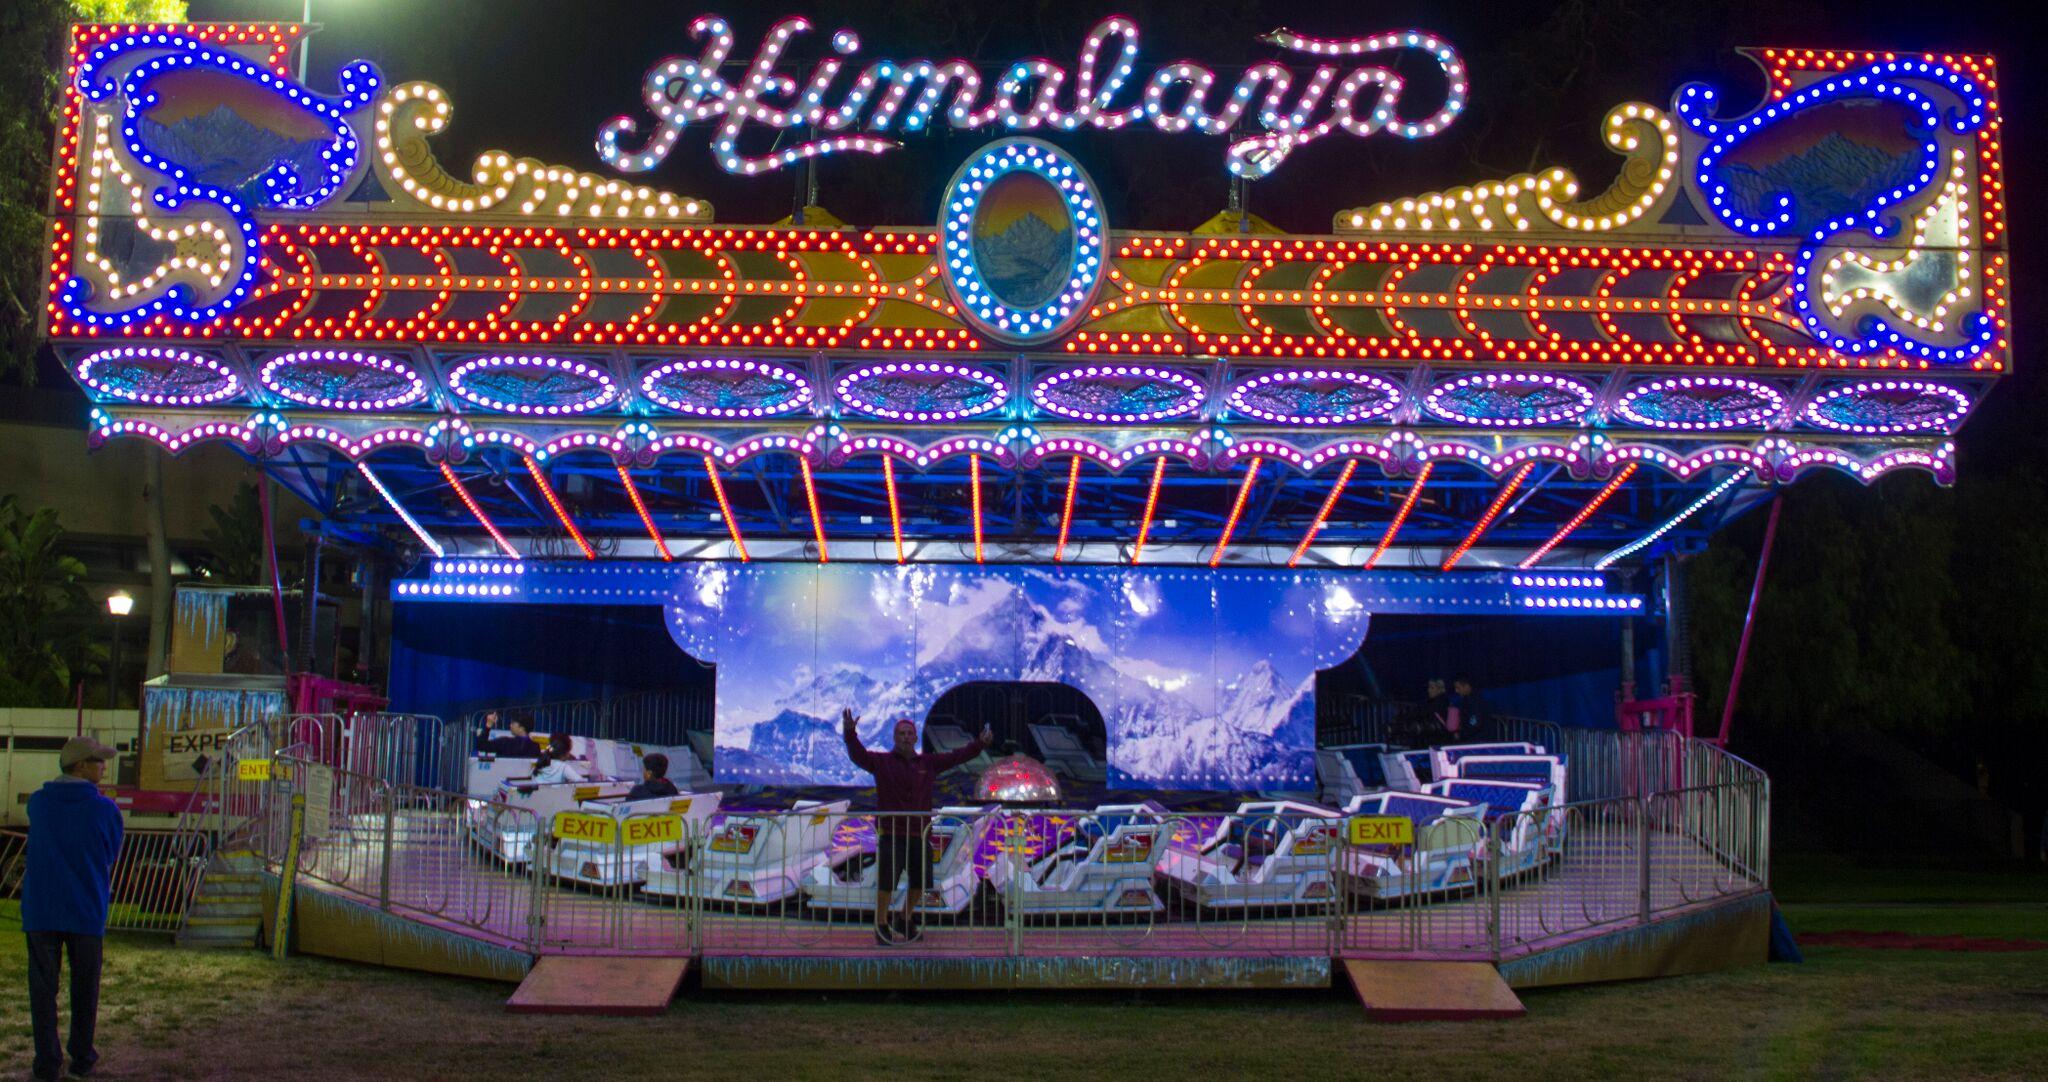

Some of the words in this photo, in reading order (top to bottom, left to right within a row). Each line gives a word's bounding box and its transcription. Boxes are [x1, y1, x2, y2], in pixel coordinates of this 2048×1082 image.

[595, 13, 1468, 178] Himalaya
[240, 763, 271, 775] ENTE
[562, 818, 608, 837] EXIT
[629, 820, 672, 839] EXIT
[1359, 822, 1403, 839] EXIT
